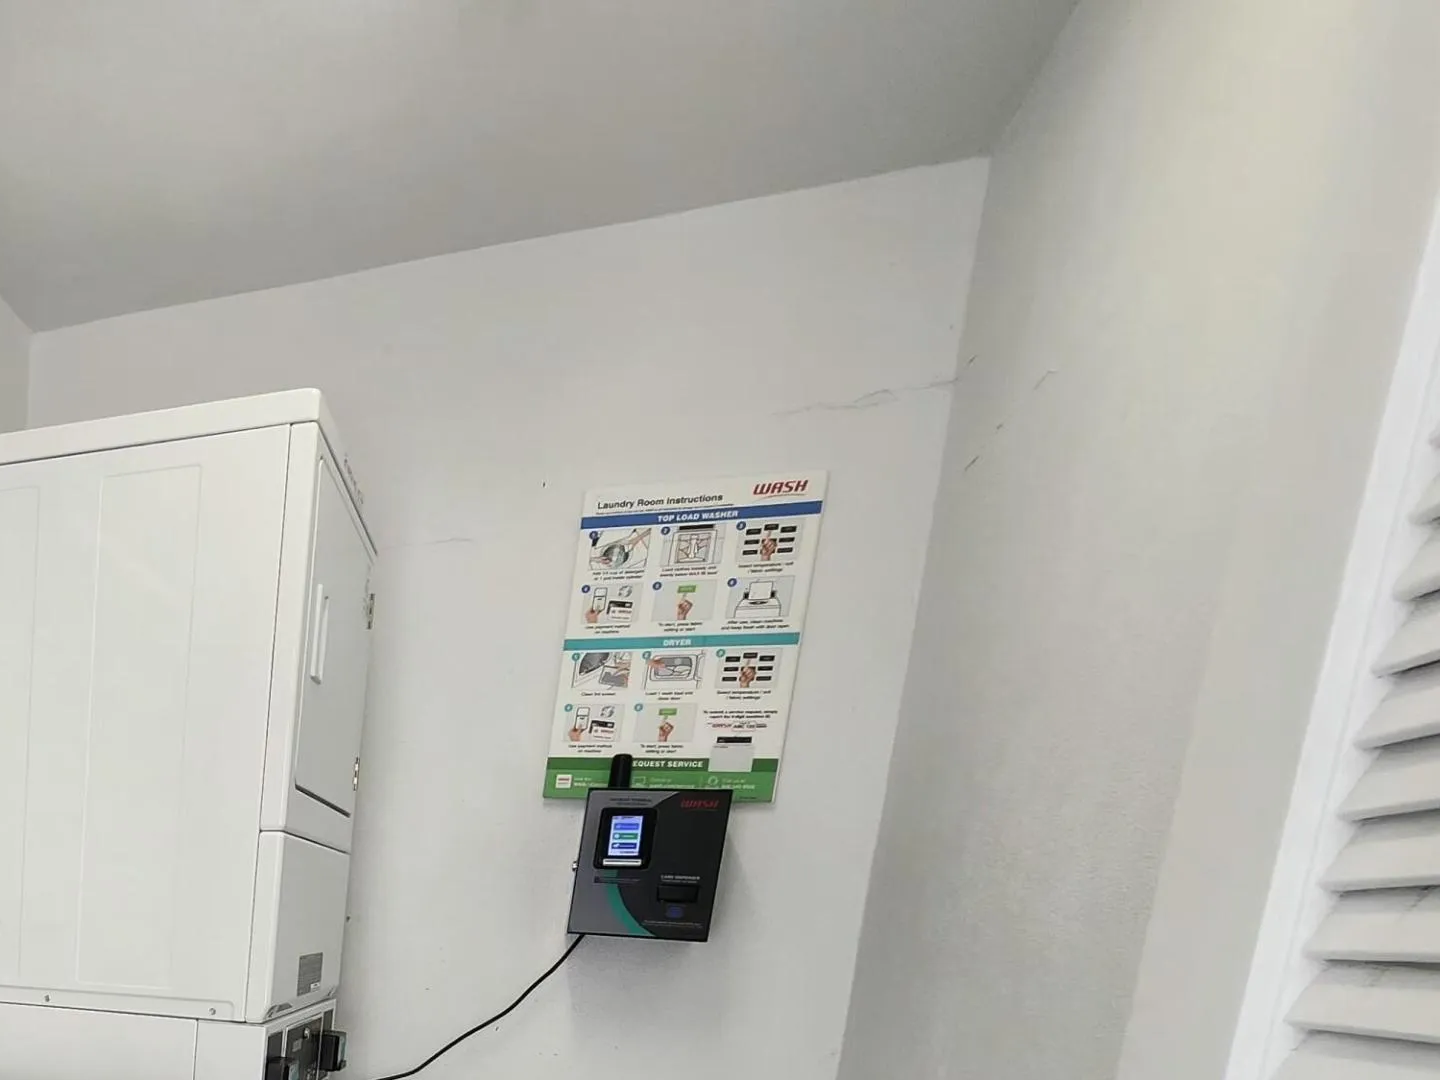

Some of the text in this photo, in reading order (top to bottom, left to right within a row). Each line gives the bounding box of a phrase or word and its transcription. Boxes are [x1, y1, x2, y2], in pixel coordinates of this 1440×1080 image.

[753, 479, 809, 496] WASH
[597, 500, 634, 510] Laundry
[637, 498, 664, 507] Room
[666, 493, 723, 505] Instructions
[657, 514, 675, 523] TOP
[676, 513, 700, 522] LOAD
[702, 510, 739, 520] WASHER
[663, 638, 691, 646] DRYER
[632, 760, 703, 769] EQUEST SERVICE
